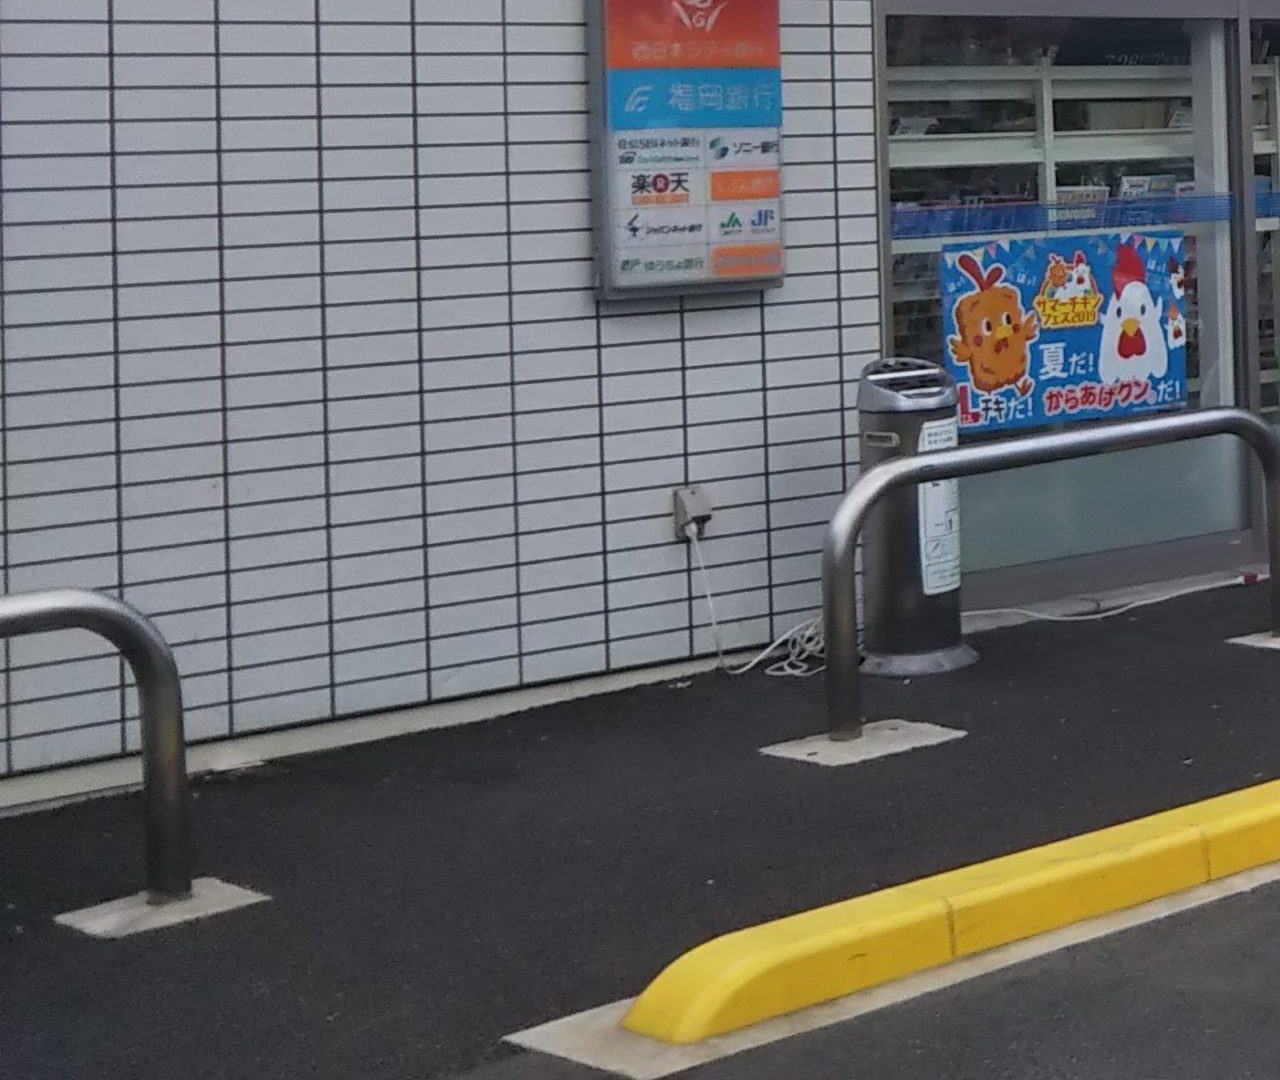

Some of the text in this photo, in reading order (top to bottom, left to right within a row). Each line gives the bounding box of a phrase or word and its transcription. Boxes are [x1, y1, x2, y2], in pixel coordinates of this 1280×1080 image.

[668, 82, 774, 112] 福岡銀行
[1036, 295, 1102, 313] サマーチキン
[1039, 341, 1095, 380] 夏だ!
